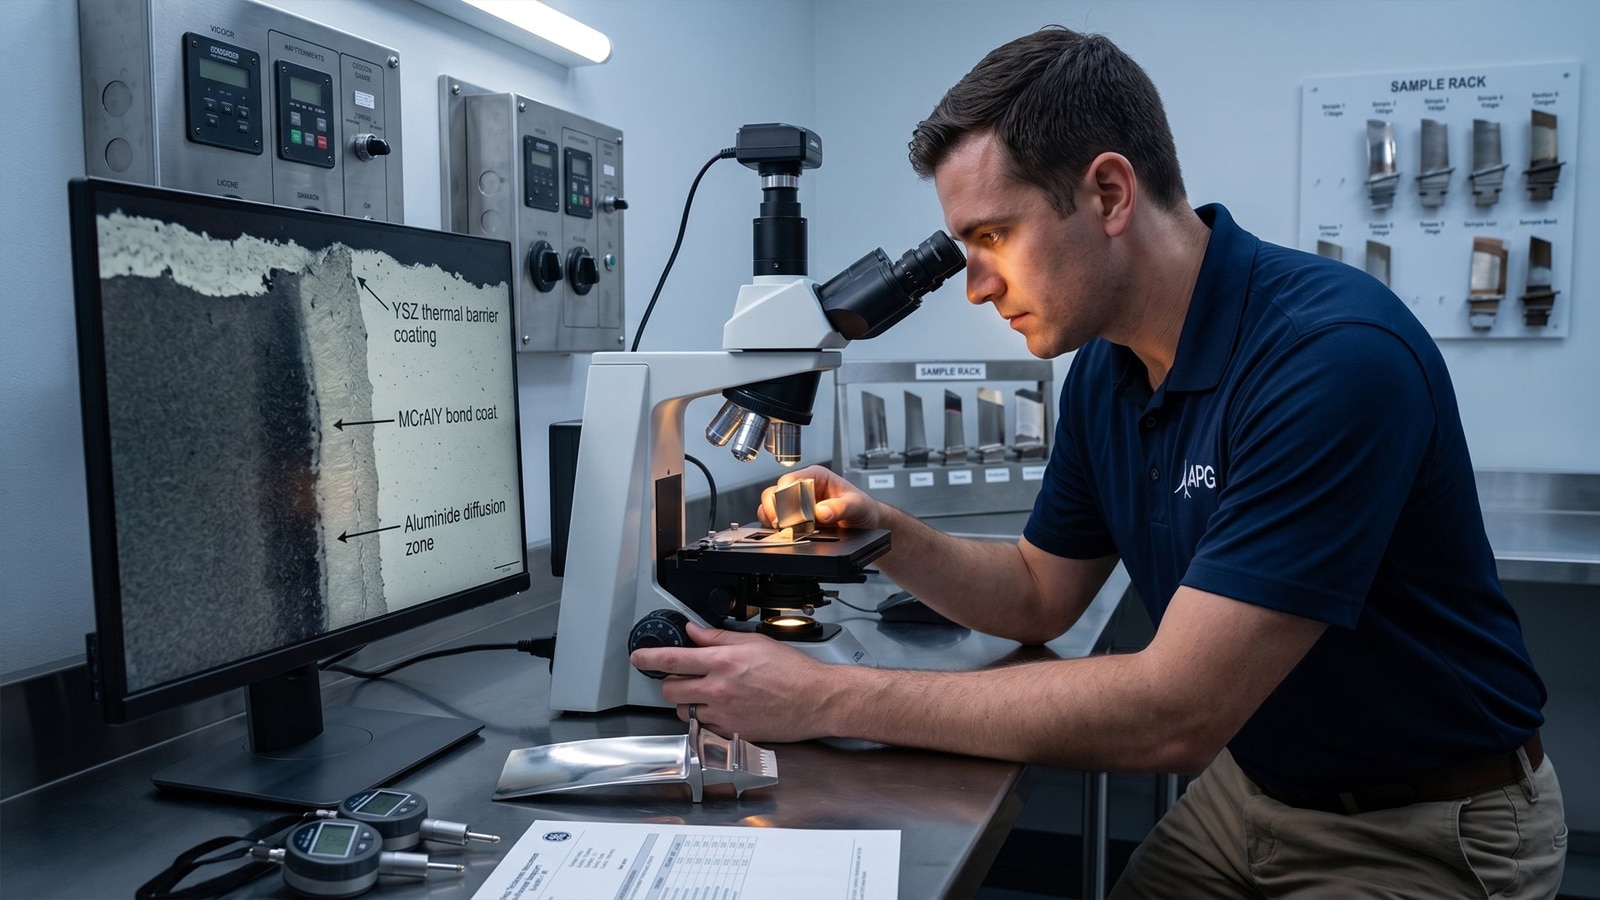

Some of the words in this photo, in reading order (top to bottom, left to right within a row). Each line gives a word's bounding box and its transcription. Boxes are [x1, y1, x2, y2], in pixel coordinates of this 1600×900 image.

[1391, 78, 1445, 93] SAMPLE
[1448, 75, 1486, 90] RACK
[392, 302, 419, 320] YSZ
[422, 303, 463, 322] thermal
[466, 306, 499, 323] barrier
[394, 326, 437, 347] coating
[921, 367, 956, 376] SAMPLE
[957, 367, 982, 376] RACK
[399, 407, 443, 428] MCrAlY
[446, 405, 473, 424] bond
[476, 405, 498, 420] coat
[1187, 464, 1216, 489] APG
[404, 506, 461, 533] Aluminide
[463, 499, 506, 520] diffusion
[405, 537, 434, 556] zone
